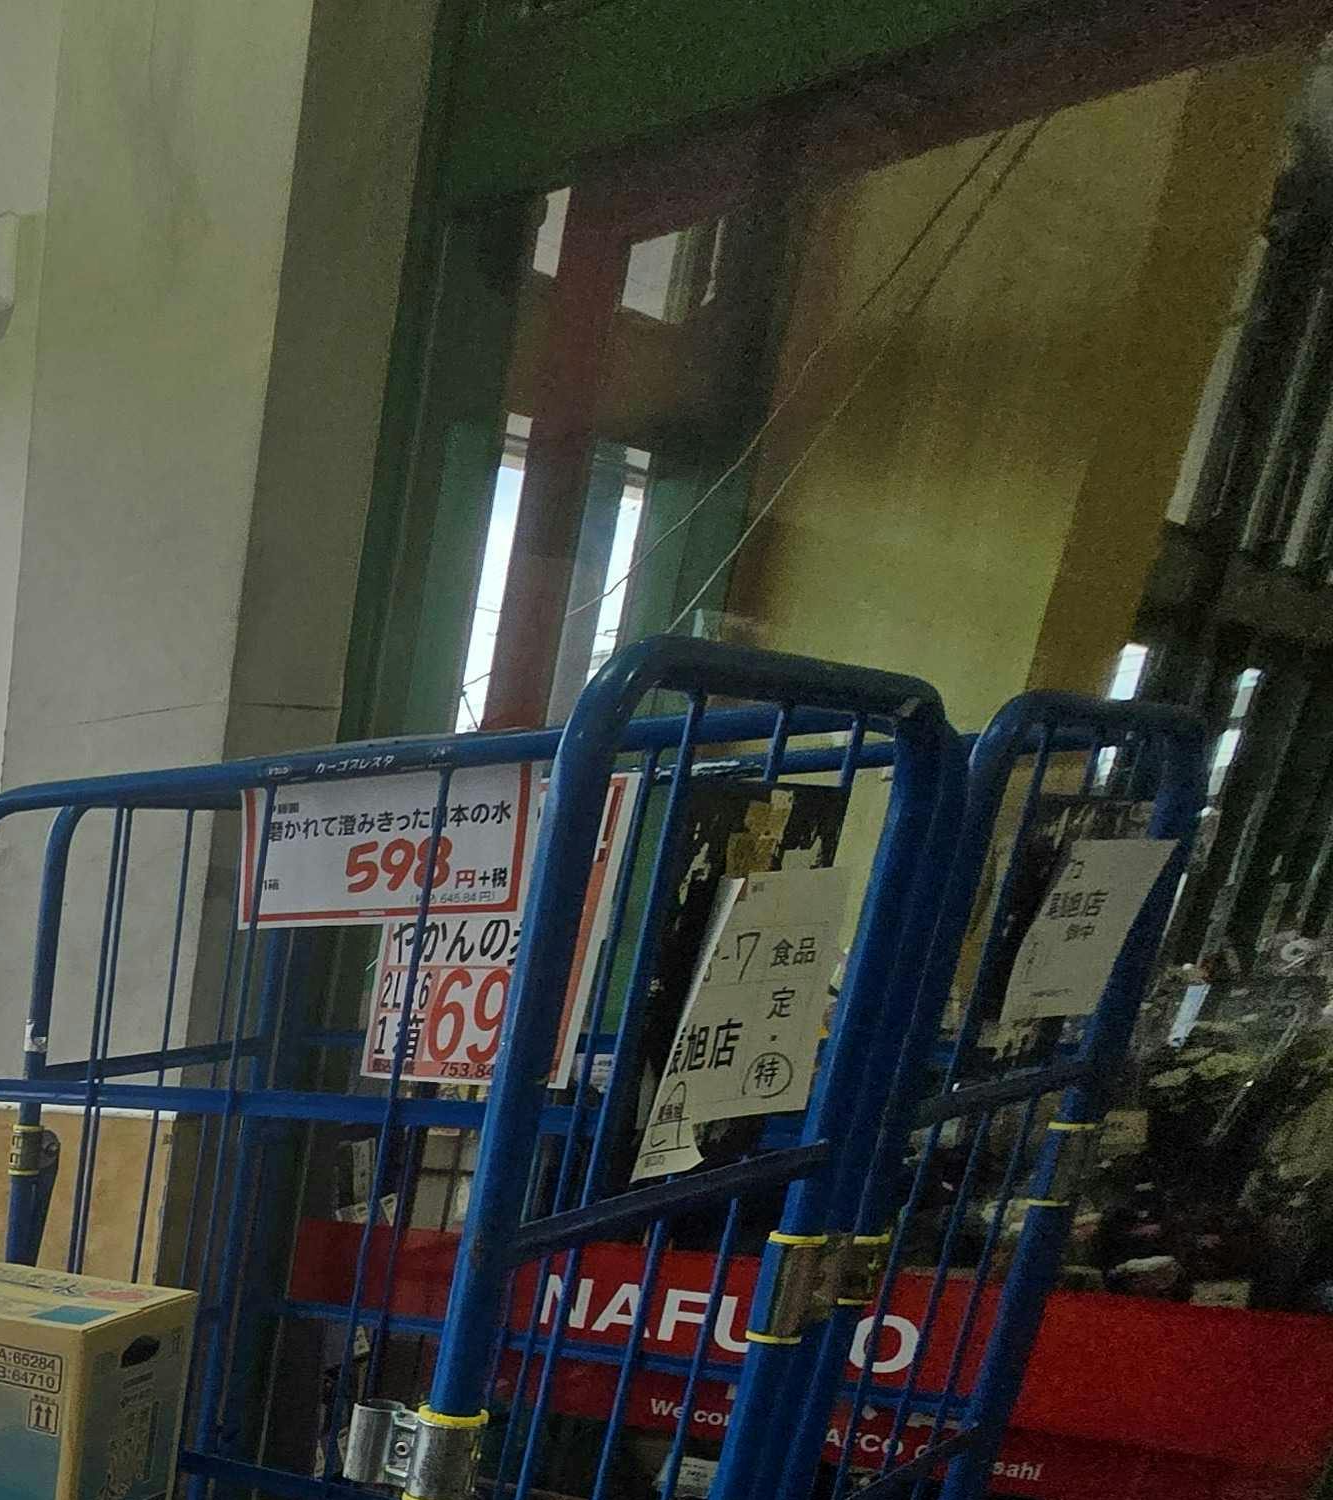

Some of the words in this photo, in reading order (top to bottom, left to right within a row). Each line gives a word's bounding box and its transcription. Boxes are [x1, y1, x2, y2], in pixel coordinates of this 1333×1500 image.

[345, 835, 453, 893] 598
[770, 936, 817, 968] 食品
[382, 971, 433, 1010] 2L6
[539, 1273, 921, 1374] NAFUO
